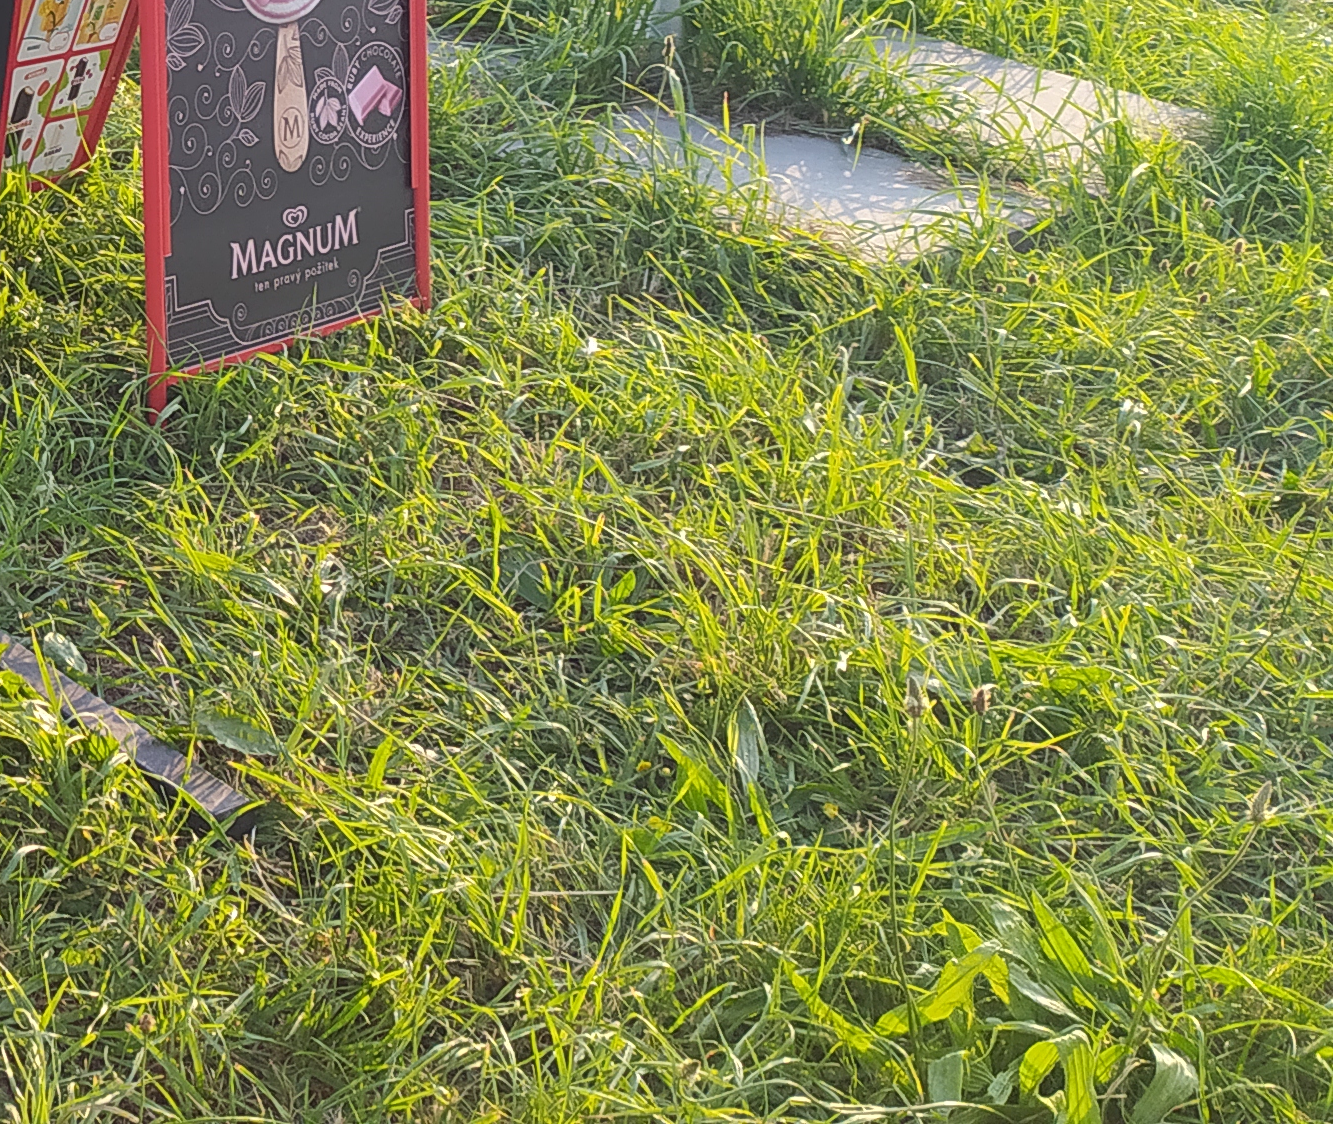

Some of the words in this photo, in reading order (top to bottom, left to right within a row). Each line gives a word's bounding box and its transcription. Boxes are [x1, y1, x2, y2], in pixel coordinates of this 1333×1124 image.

[347, 62, 362, 90] RUBY
[360, 46, 402, 79] CHOCOLATE
[281, 114, 301, 142] M
[230, 207, 360, 280] MAGNUM
[254, 278, 270, 293] ten
[273, 268, 302, 290] pravý
[304, 257, 340, 281] požitek
